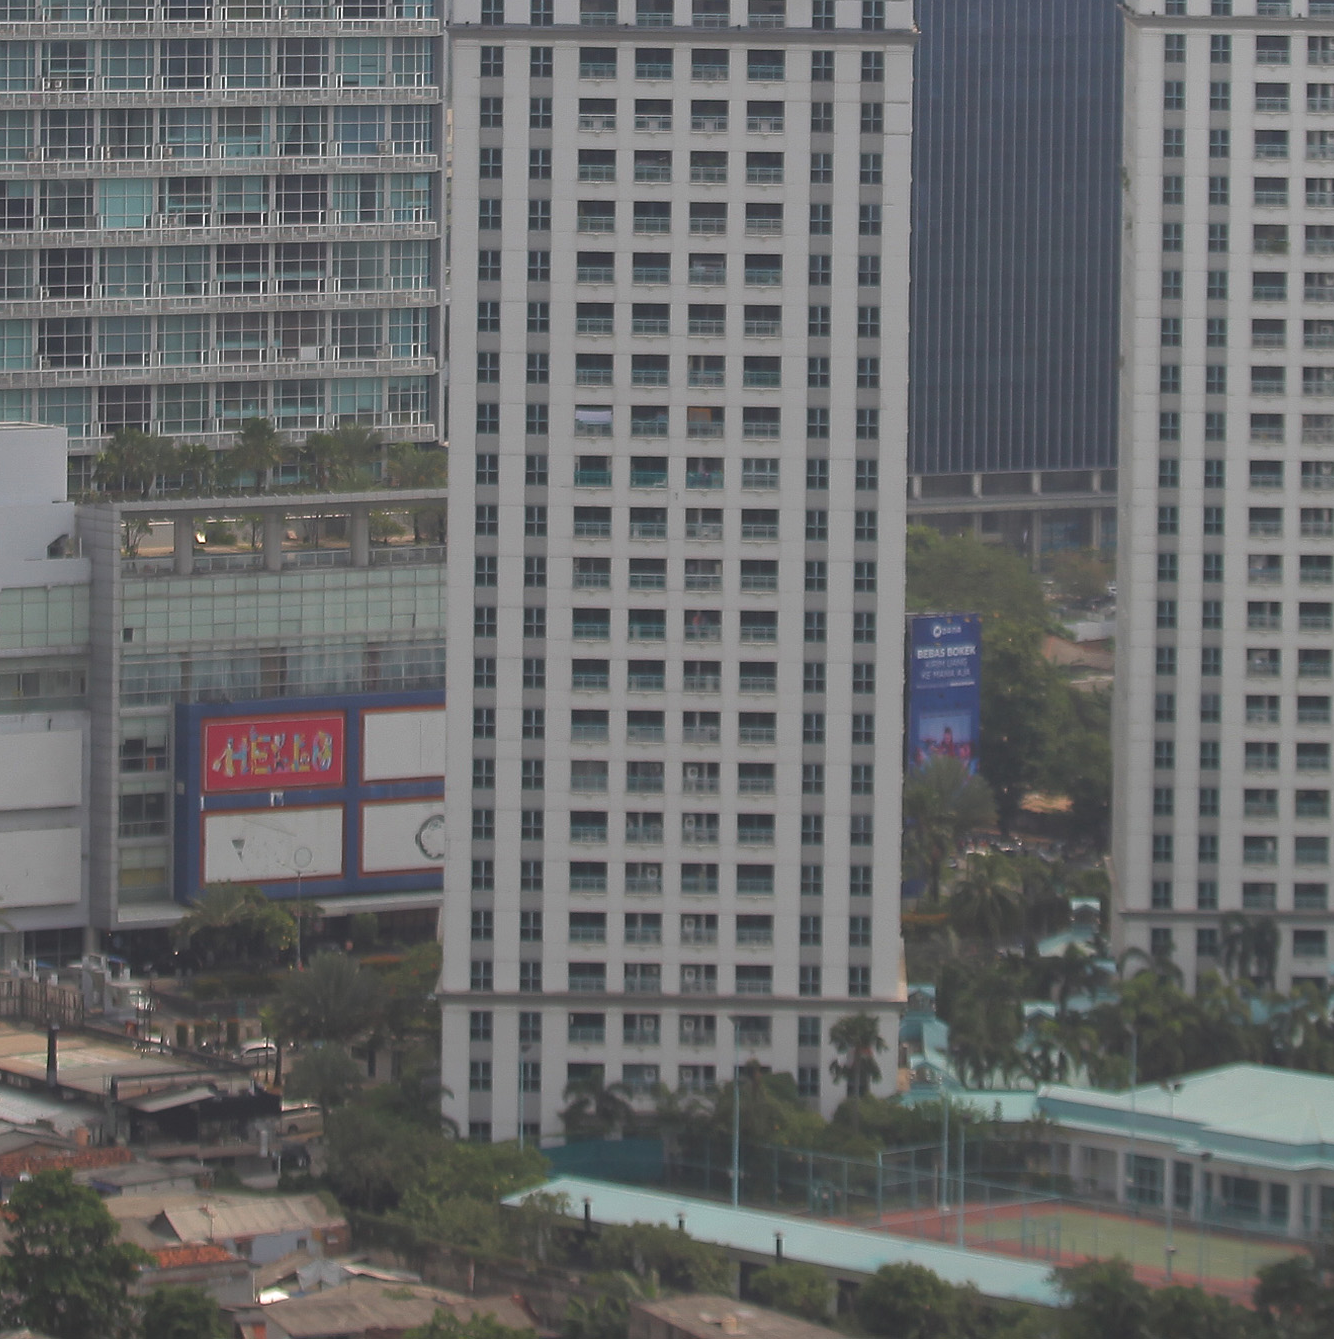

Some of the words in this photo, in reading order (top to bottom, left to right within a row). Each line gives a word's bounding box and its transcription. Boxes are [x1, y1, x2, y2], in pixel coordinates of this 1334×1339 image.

[917, 648, 945, 659] BEBAS
[947, 646, 976, 657] BOKEK
[213, 725, 333, 778] HELLO
